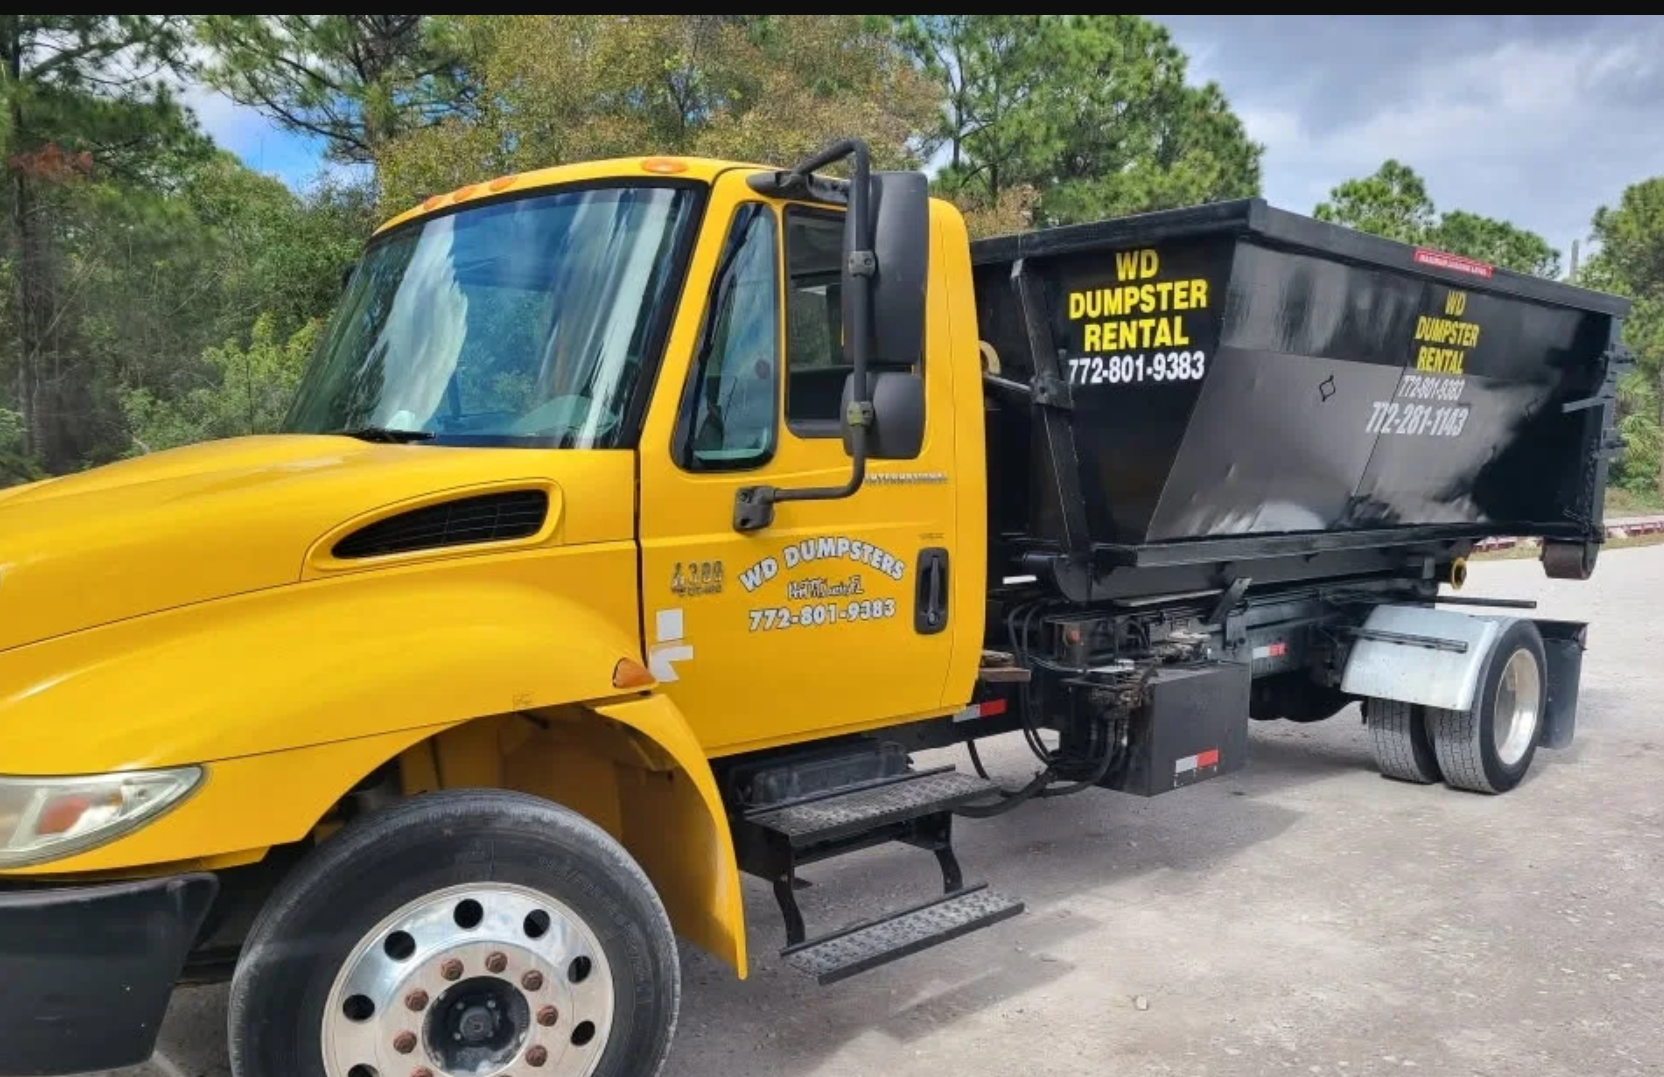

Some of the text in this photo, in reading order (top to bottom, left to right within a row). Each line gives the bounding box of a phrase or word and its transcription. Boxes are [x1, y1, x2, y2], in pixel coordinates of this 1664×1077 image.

[1116, 249, 1160, 281] WD
[1069, 279, 1209, 320] DUMPSTER
[1445, 289, 1468, 316] WD
[1084, 315, 1189, 352] RENTAL
[1414, 316, 1480, 348] DUMPSTER
[1068, 350, 1205, 385] 772-801-9383
[1416, 346, 1464, 375] RENTAL
[1365, 401, 1469, 436] 772-281-1143
[739, 556, 779, 593] WD
[782, 537, 906, 580] DUMPSTERS
[748, 599, 896, 632] 772-801-9383
